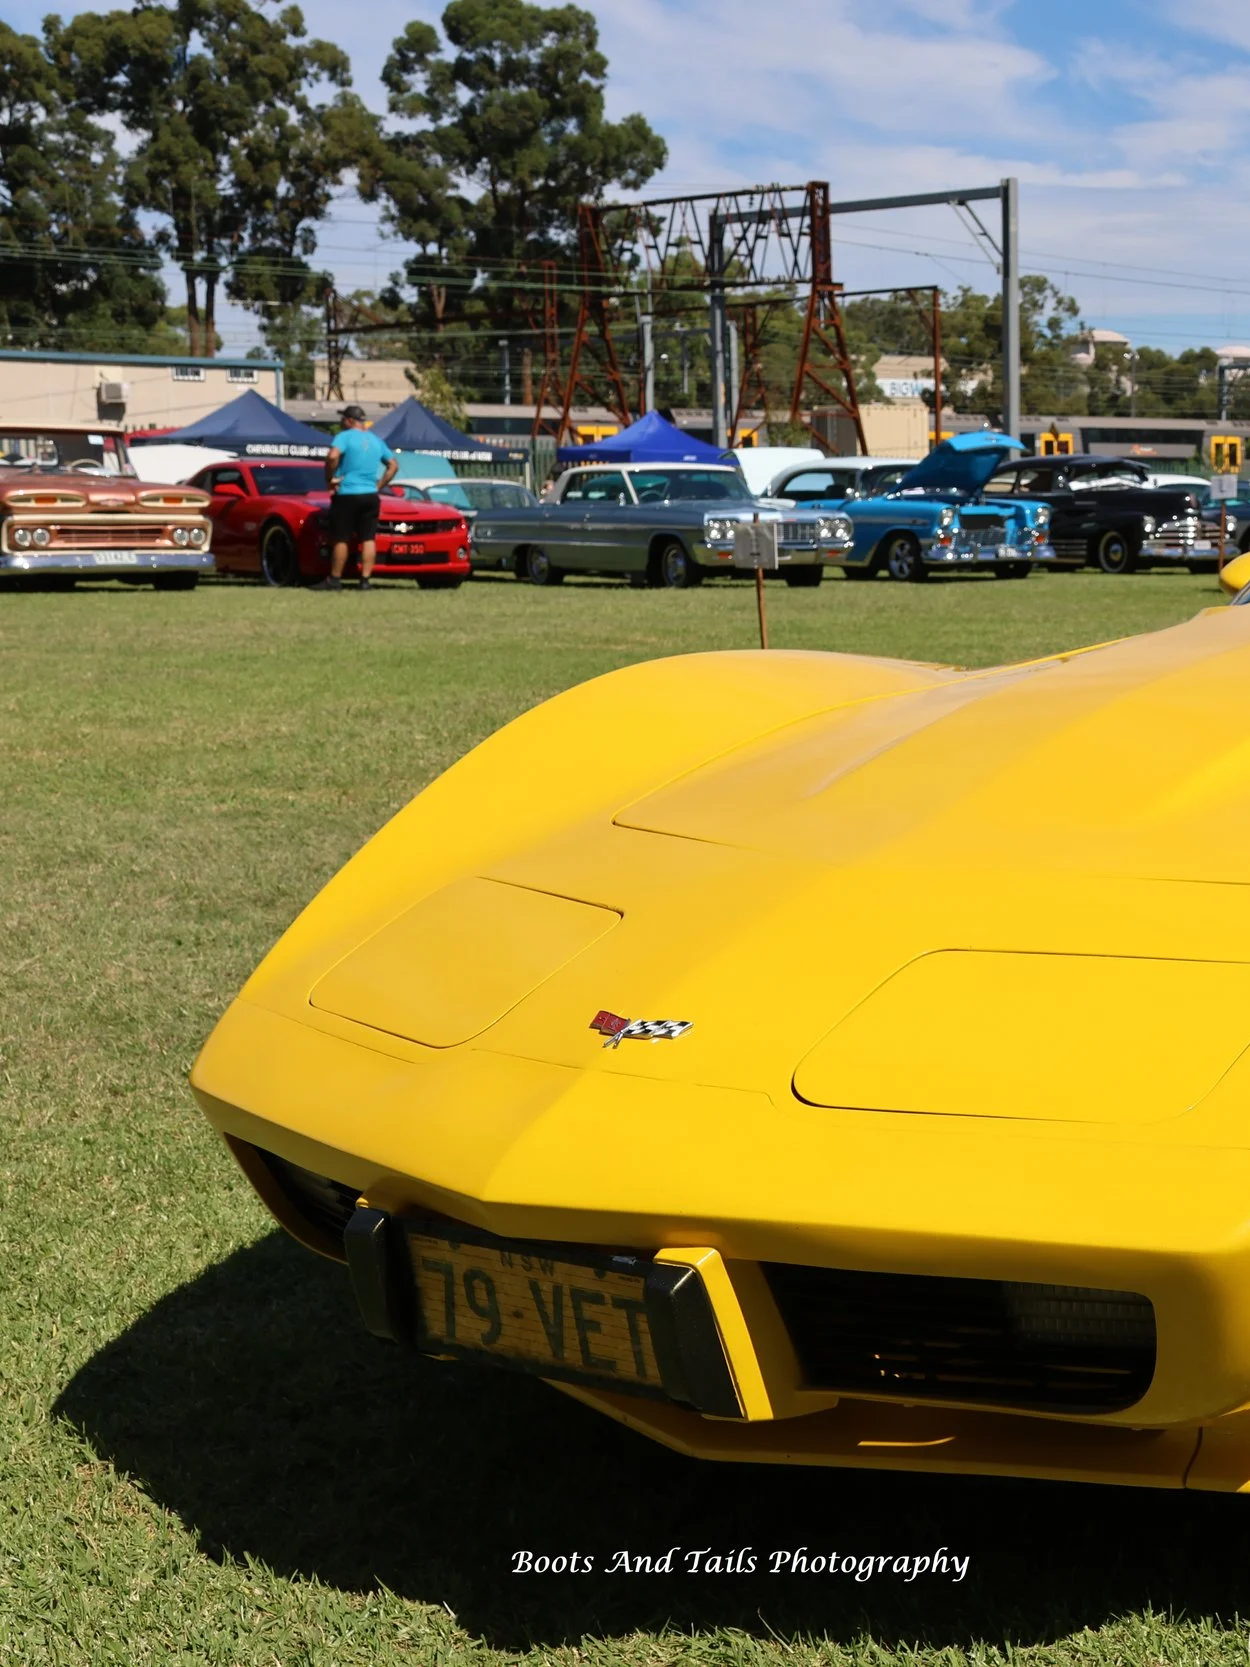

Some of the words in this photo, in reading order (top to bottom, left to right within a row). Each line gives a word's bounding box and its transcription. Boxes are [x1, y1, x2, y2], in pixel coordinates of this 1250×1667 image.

[246, 443, 289, 457] CHEVROLET
[289, 445, 310, 458] CLUB
[500, 1251, 556, 1278] NSW
